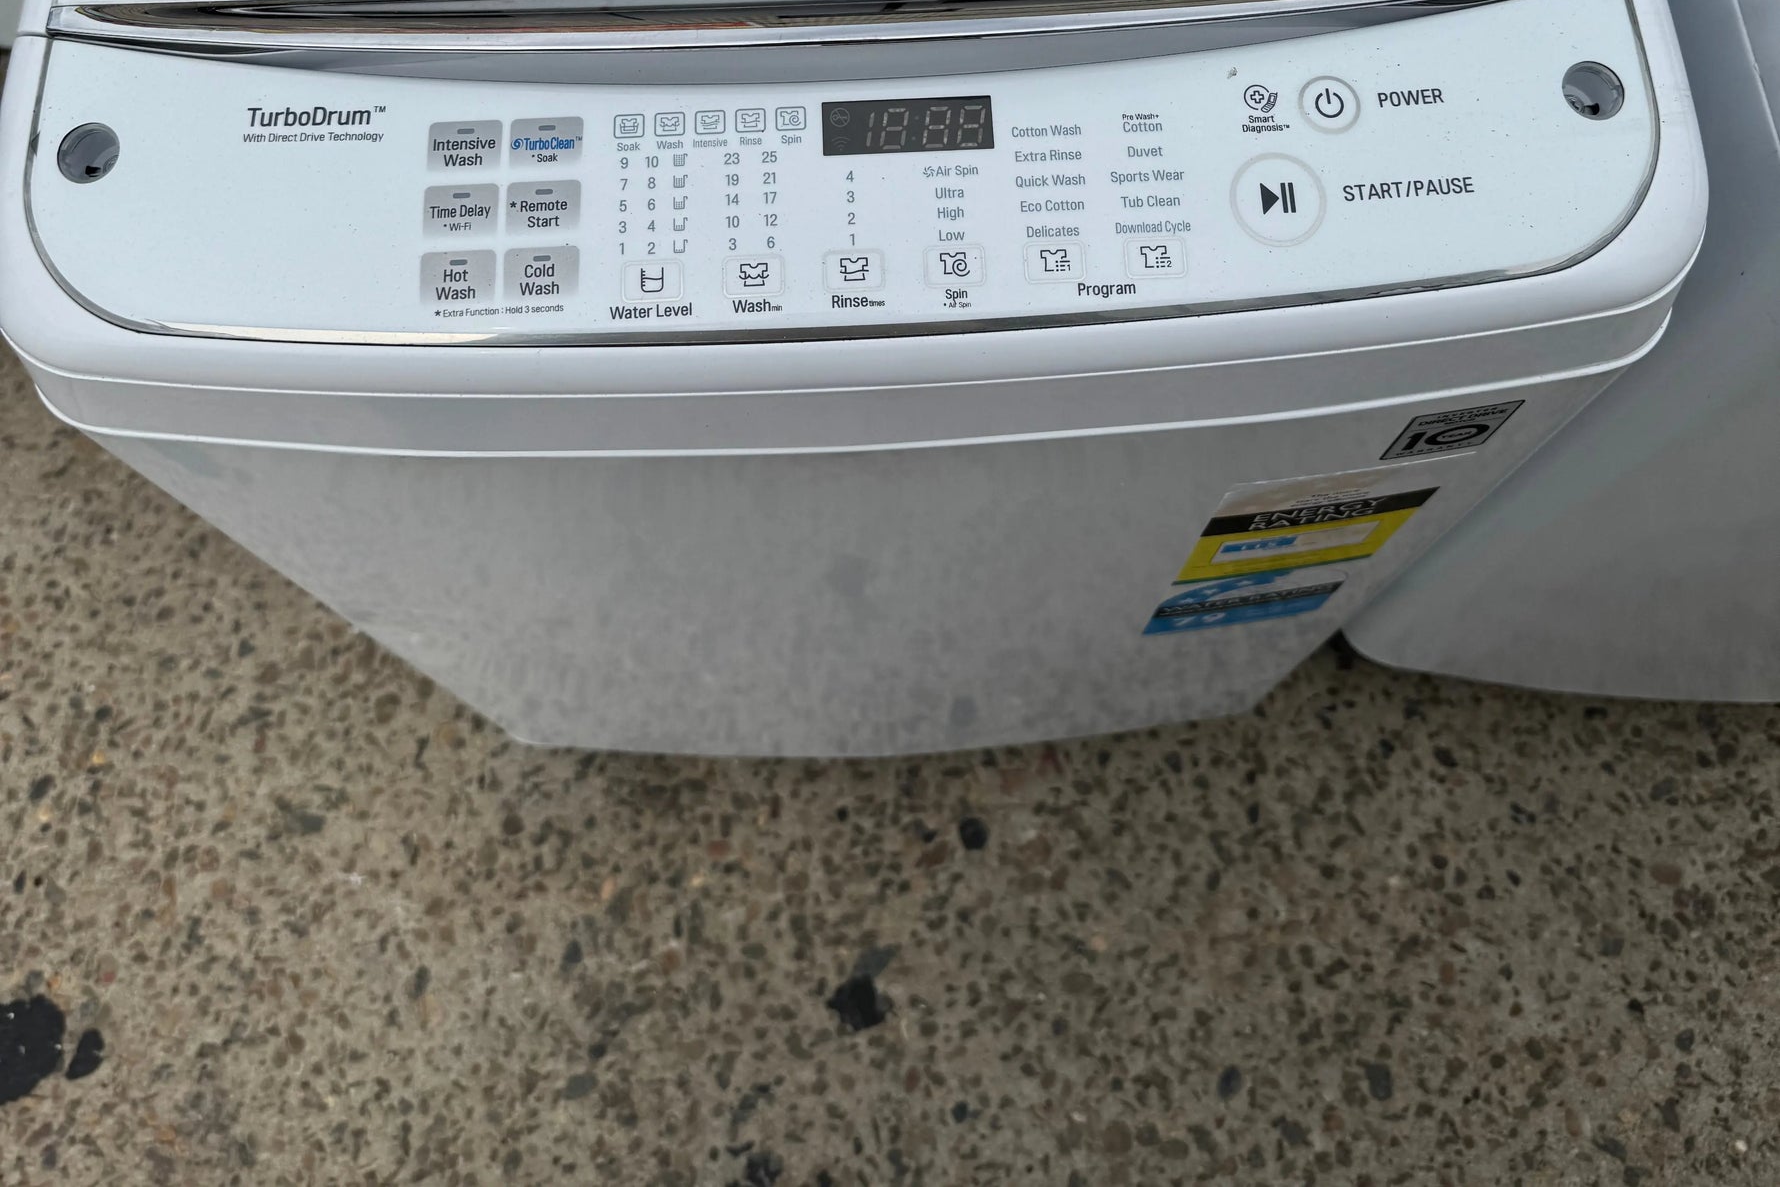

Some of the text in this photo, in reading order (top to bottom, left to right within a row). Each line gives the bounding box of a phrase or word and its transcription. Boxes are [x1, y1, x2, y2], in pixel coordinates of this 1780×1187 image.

[1377, 88, 1445, 108] POWER
[1248, 115, 1275, 124] Smart
[1011, 124, 1082, 138] Cotton Wash
[1122, 121, 1163, 133] Cotton
[243, 131, 384, 143] With Direct Drive Technology
[433, 137, 496, 151] Intensive
[692, 137, 728, 148] Intensive
[739, 136, 762, 146] Rinse
[781, 134, 802, 145] Spin
[616, 142, 641, 152] Soak
[656, 139, 684, 150] Wash
[537, 153, 558, 163] Soak
[724, 150, 777, 165] 23 25
[1015, 149, 1082, 163] Extra Rinse
[1127, 146, 1163, 158] Duvet
[443, 153, 483, 167] Wash
[620, 155, 659, 169] 9 10
[935, 165, 979, 177] Air Spin
[1110, 169, 1185, 185] Sports Wear
[1015, 173, 1086, 188] Quick Wash
[935, 188, 965, 199] Ultra
[1342, 176, 1475, 202] START/PAUSE
[520, 200, 568, 213] Remote
[1020, 199, 1085, 213] Eco Cotton
[1120, 195, 1181, 208] Tub Clean
[430, 204, 491, 219] Time Delay
[937, 206, 965, 221] High
[449, 222, 472, 231] Wi-Fi
[527, 216, 560, 228] Start
[1115, 220, 1192, 235] Download Cycle
[938, 229, 965, 242] Low
[1026, 225, 1080, 238] Delicates
[443, 269, 469, 283] Hot
[524, 264, 555, 278] Cold
[435, 286, 476, 301] Wash
[519, 281, 560, 296] Wash
[945, 288, 968, 303] Spin
[1077, 282, 1137, 298] Program
[443, 309, 463, 318] Extra
[505, 306, 523, 314] Hold
[524, 305, 530, 313] 3
[531, 304, 564, 313] seconds
[609, 302, 692, 320] Water Level
[1253, 496, 1388, 523] ENERGY
[1248, 507, 1375, 531] RATING
